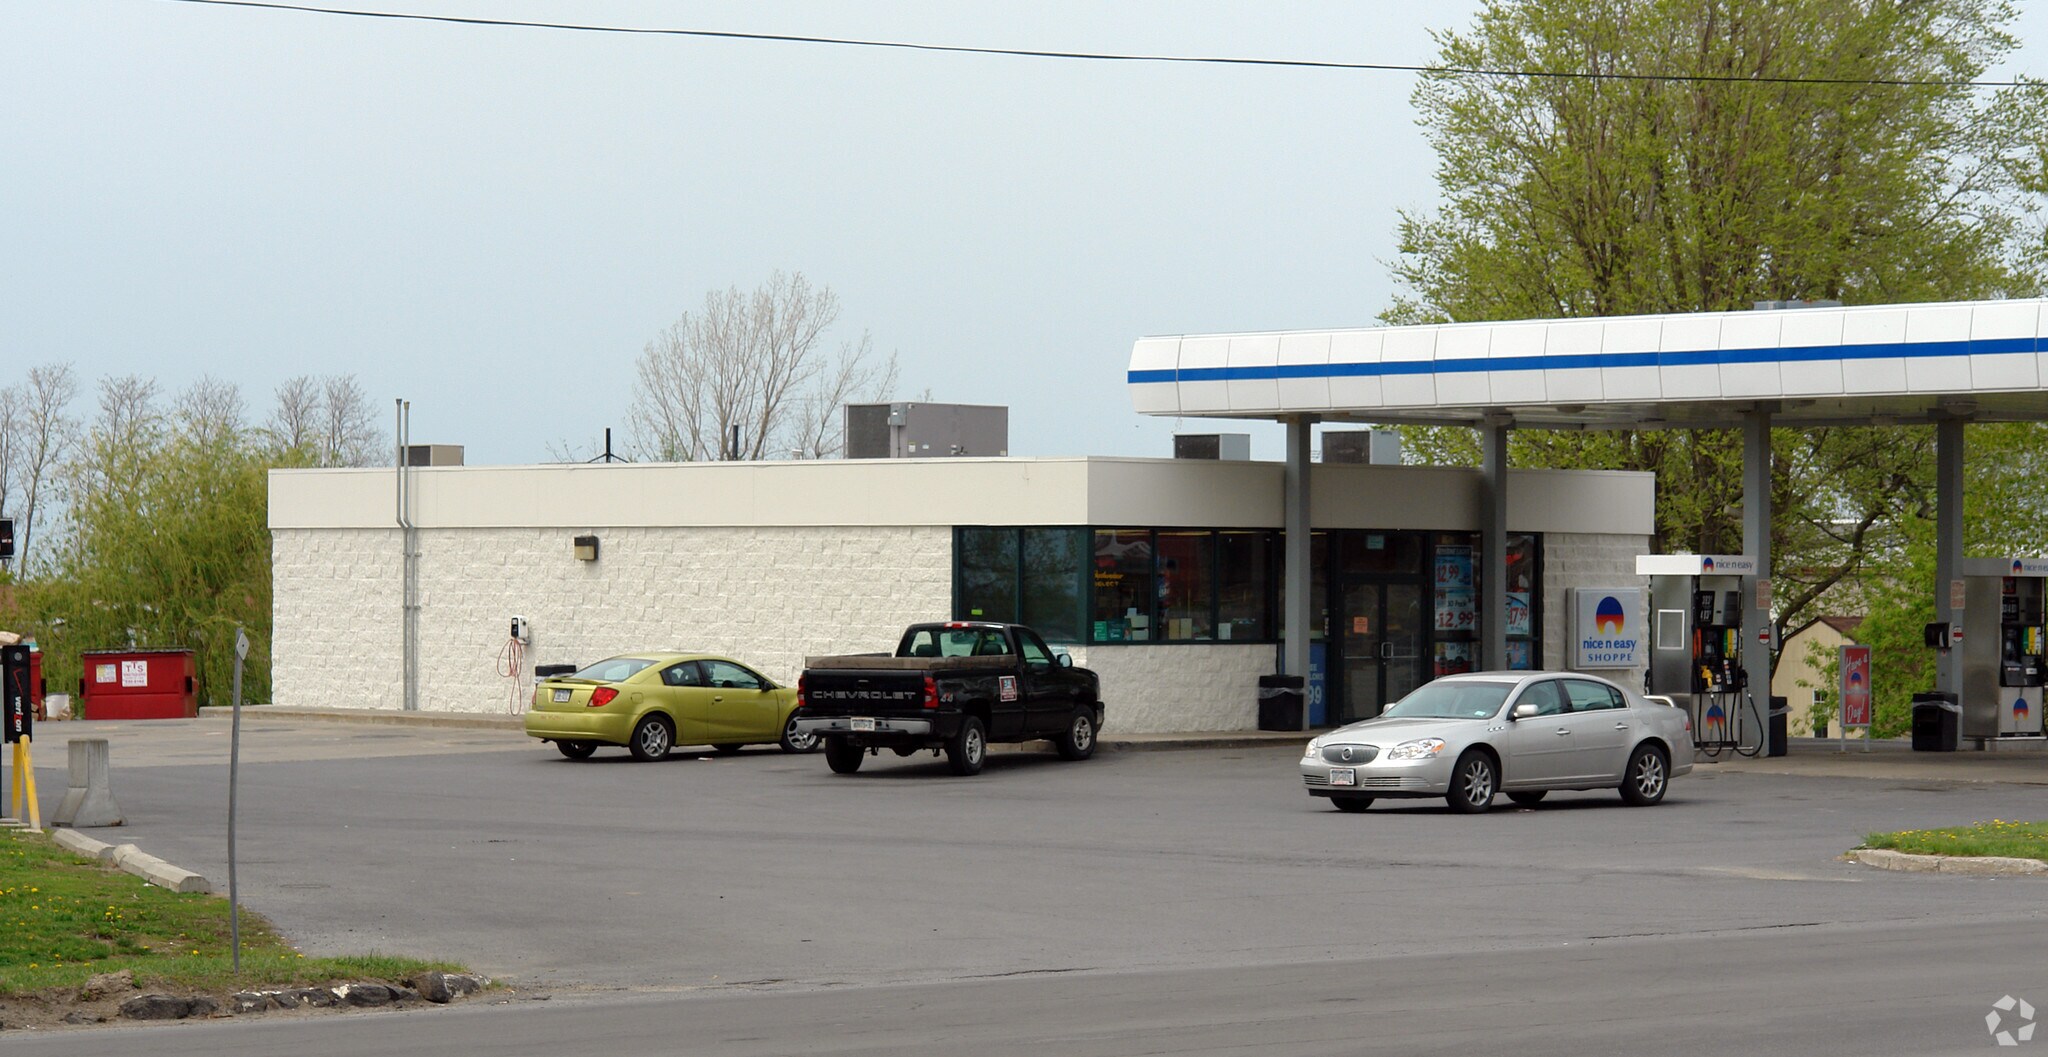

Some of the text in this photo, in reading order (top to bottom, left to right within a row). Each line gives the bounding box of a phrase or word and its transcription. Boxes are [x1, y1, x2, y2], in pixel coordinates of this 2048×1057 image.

[1716, 559, 1731, 569] nice
[1738, 562, 1754, 571] easy
[1438, 610, 1475, 629] 12.99
[1583, 636, 1637, 652] nice n easy
[1588, 653, 1633, 662] SHOPPE
[811, 690, 917, 700] CHEVROLET
[14, 696, 24, 732] verizon
